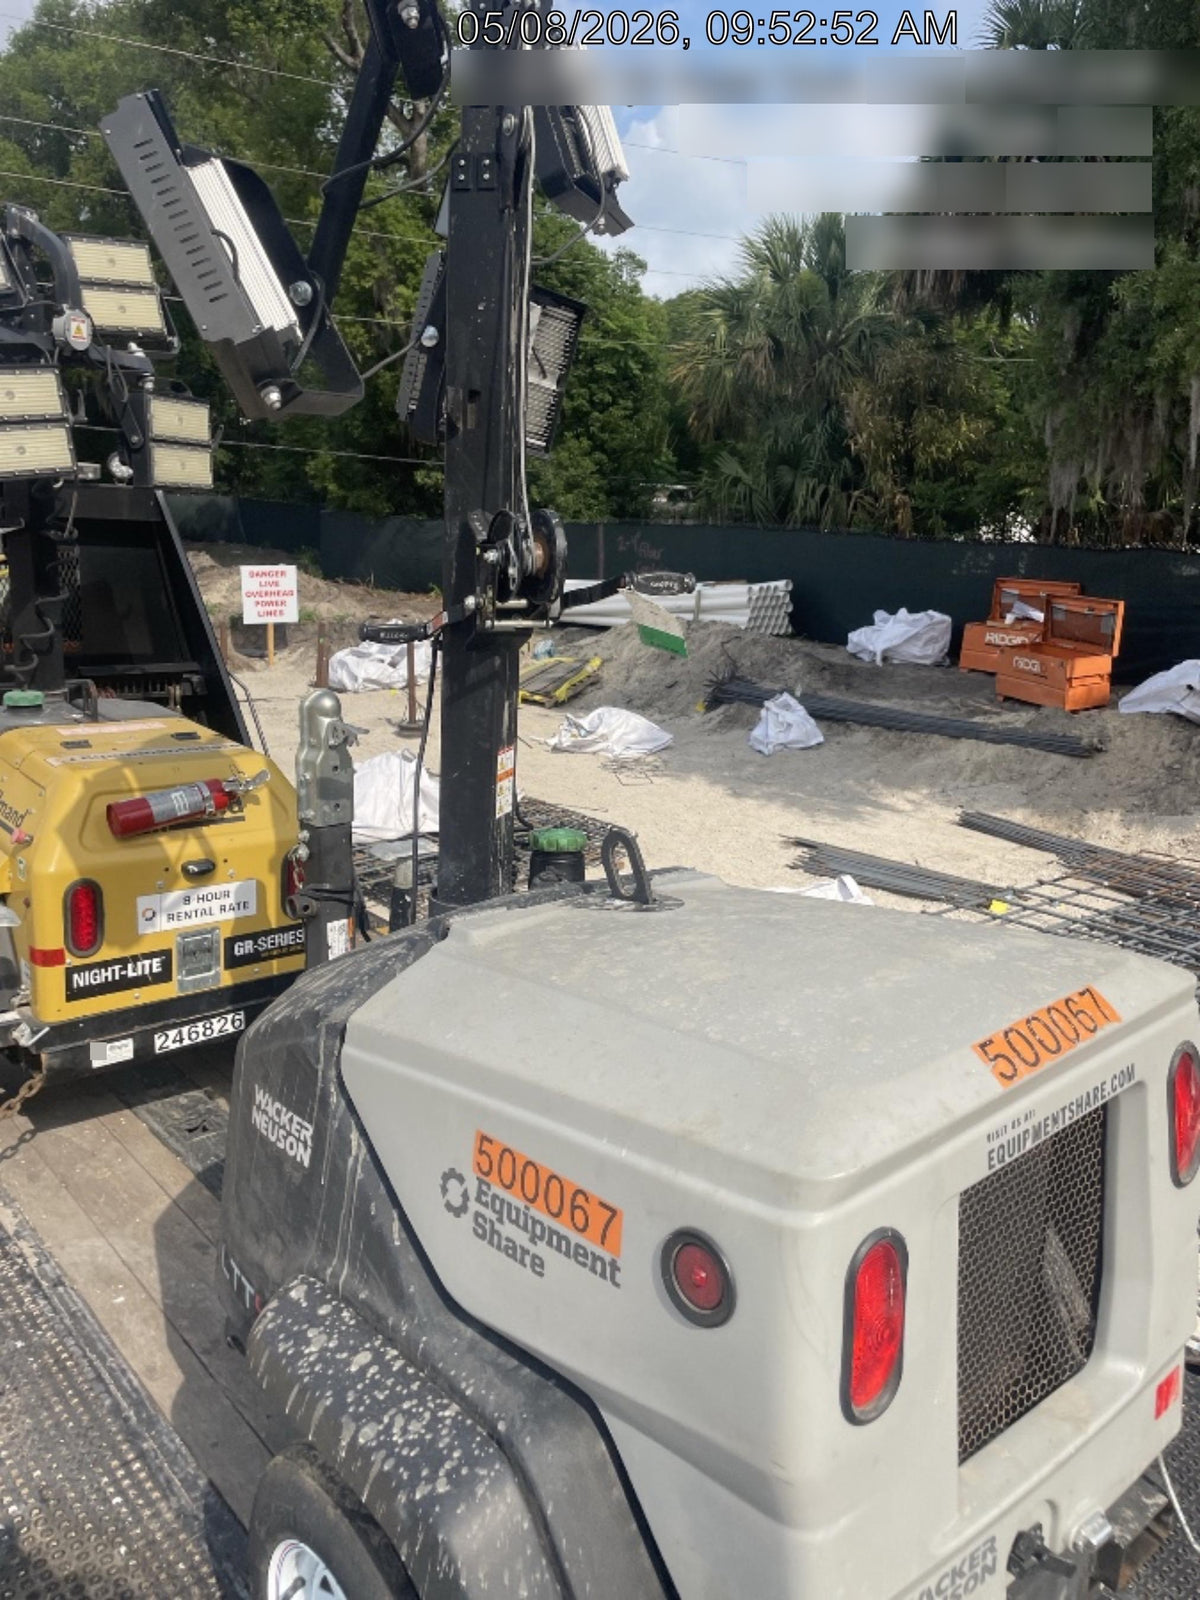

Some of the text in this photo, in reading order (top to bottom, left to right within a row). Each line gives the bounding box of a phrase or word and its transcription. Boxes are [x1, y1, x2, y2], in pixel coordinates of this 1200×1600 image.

[245, 590, 294, 598] OVERHEAD
[249, 570, 286, 578] DANGER
[167, 900, 250, 923] RENTAL RATE
[234, 929, 305, 957] GR-SERIES
[157, 1012, 243, 1052] 246826
[977, 987, 1111, 1082] 500067
[251, 1104, 312, 1169] NEUSON
[254, 1083, 314, 1149] WACKER
[987, 1063, 1135, 1171] EQUIPMENTSHARE.COM
[987, 1125, 1008, 1144] VISIT
[476, 1133, 618, 1248] 500067
[472, 1209, 545, 1279] Share
[474, 1175, 622, 1290] Equipment
[917, 1534, 998, 1600] ACKER
